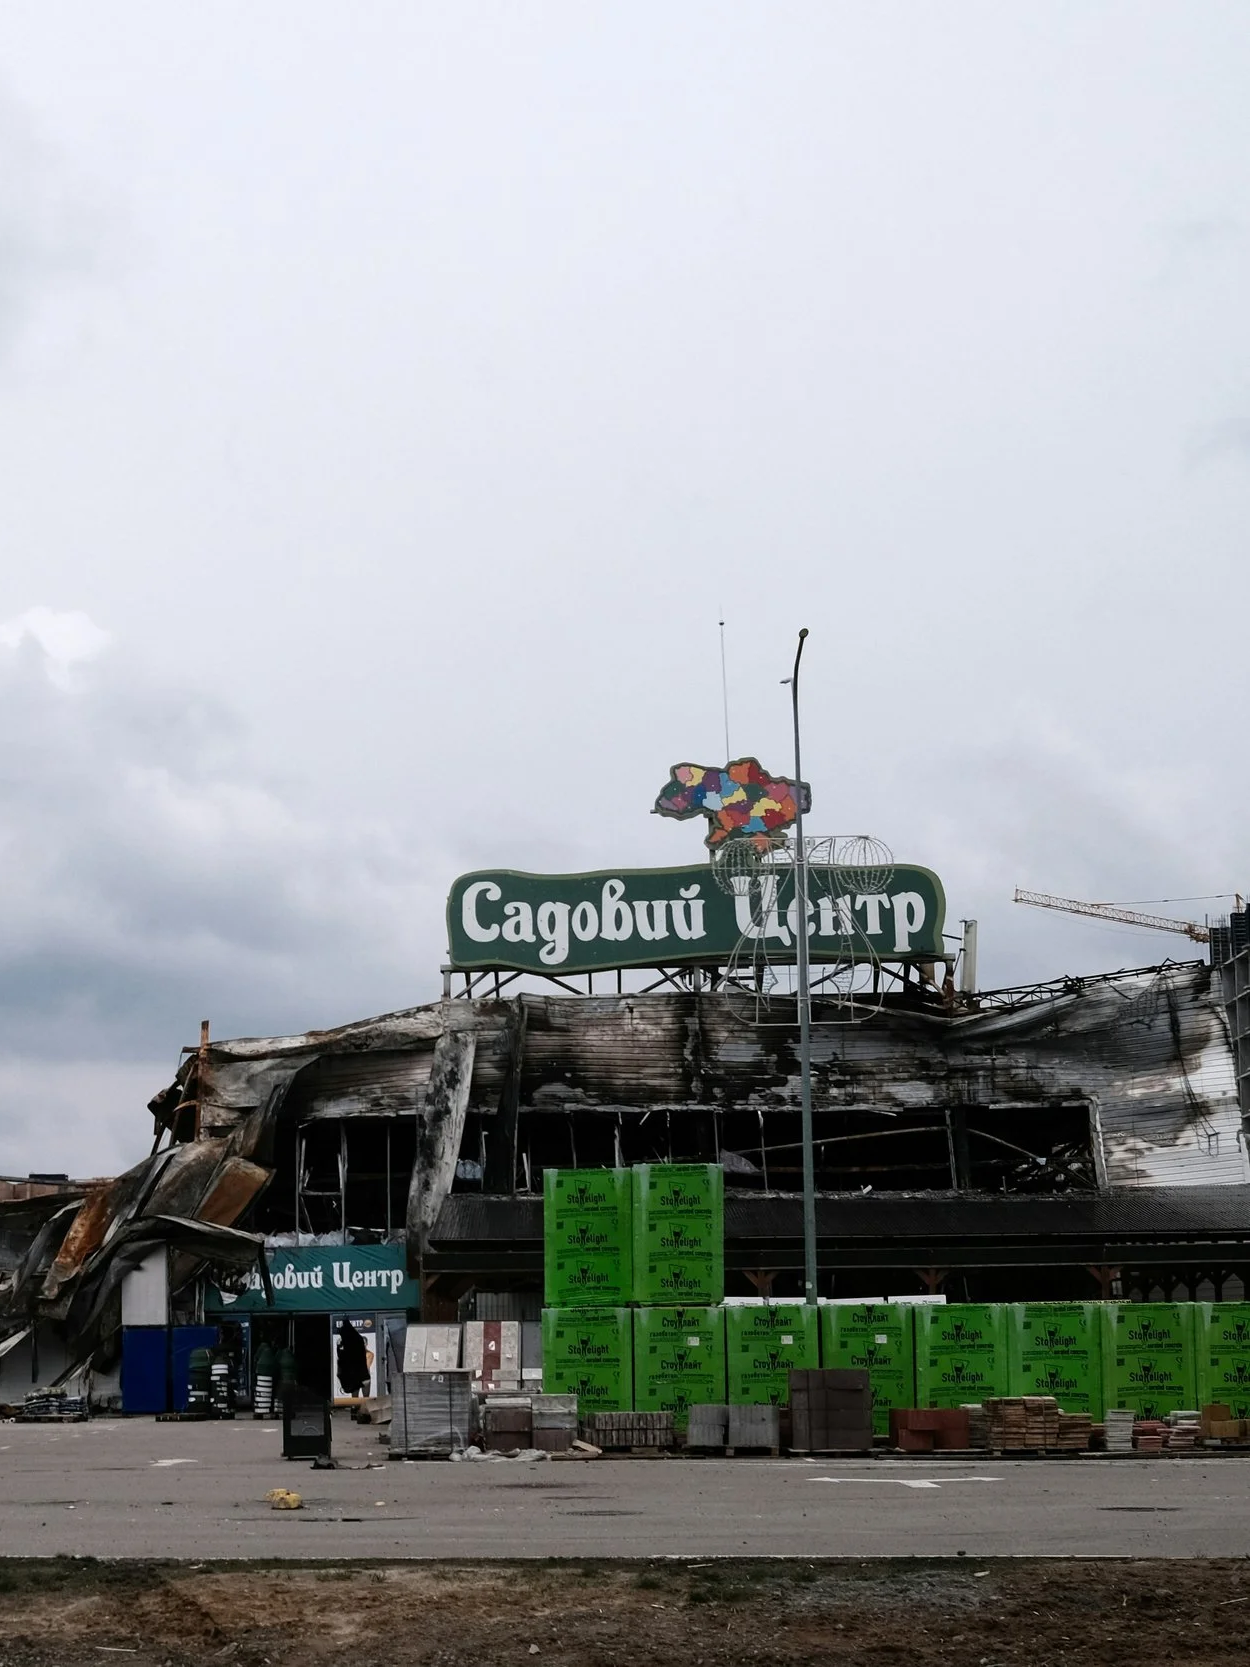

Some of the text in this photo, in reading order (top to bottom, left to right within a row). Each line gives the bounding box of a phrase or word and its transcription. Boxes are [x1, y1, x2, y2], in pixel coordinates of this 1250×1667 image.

[462, 875, 926, 964] Садовий Центр
[242, 1262, 404, 1299] аовий Центр
